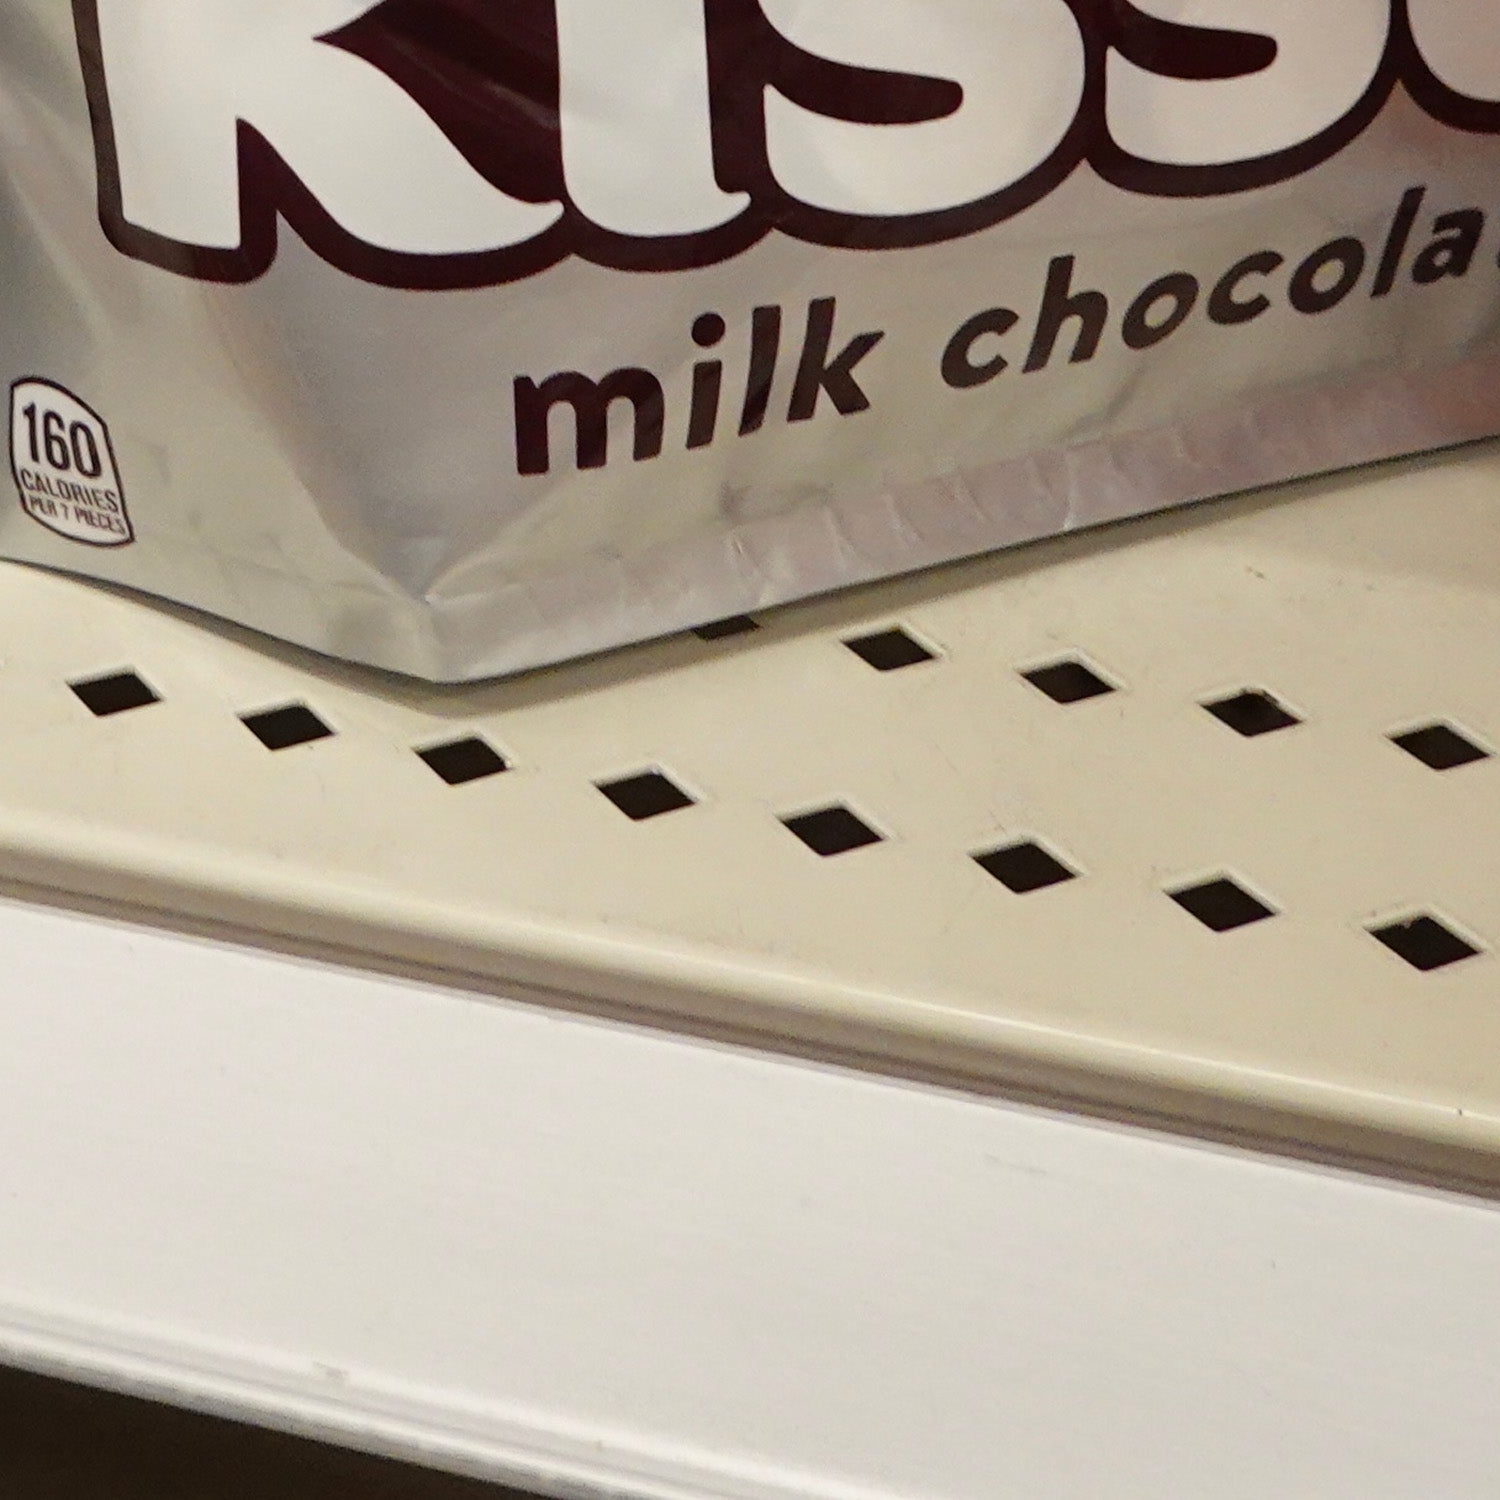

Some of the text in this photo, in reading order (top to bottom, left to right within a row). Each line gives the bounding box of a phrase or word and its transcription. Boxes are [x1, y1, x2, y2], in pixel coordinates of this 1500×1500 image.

[512, 298, 885, 476] milk
[22, 401, 102, 478] 160
[20, 468, 119, 514] CALORIES
